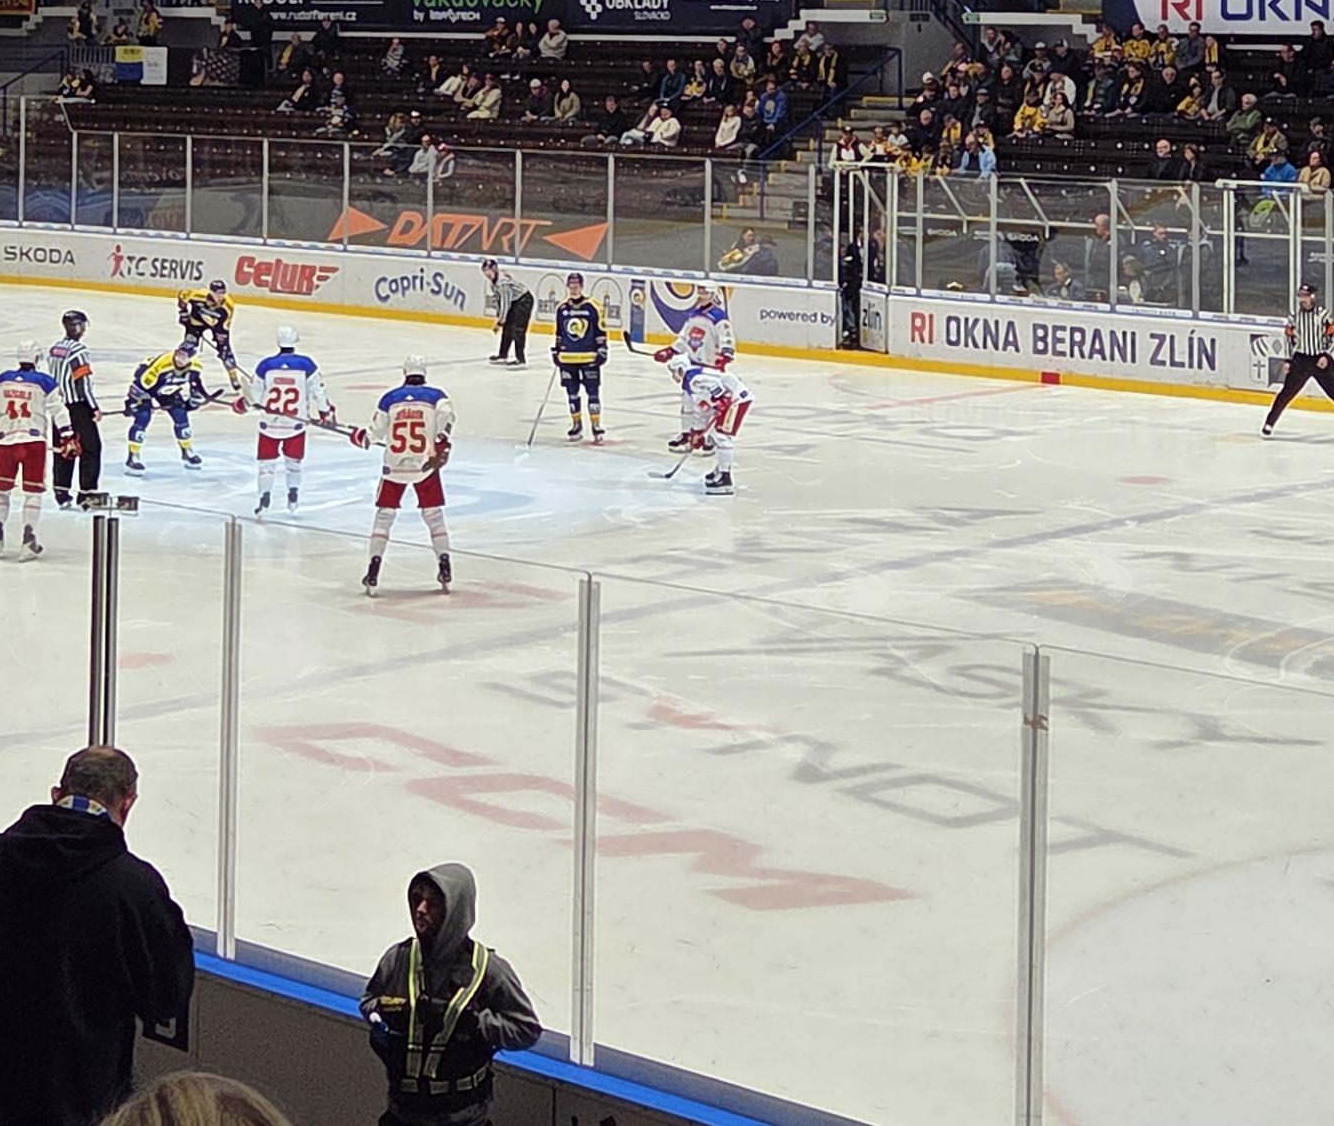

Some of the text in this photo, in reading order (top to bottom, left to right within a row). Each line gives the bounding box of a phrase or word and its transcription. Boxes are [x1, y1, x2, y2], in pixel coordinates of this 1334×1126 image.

[125, 255, 204, 281] TC SERVIS
[375, 267, 467, 311] Capri-Sun
[759, 308, 837, 328] powered by
[909, 311, 1217, 371] RI OKNA BERANI ZLÍN
[266, 386, 300, 416] 22
[389, 421, 427, 454] 55
